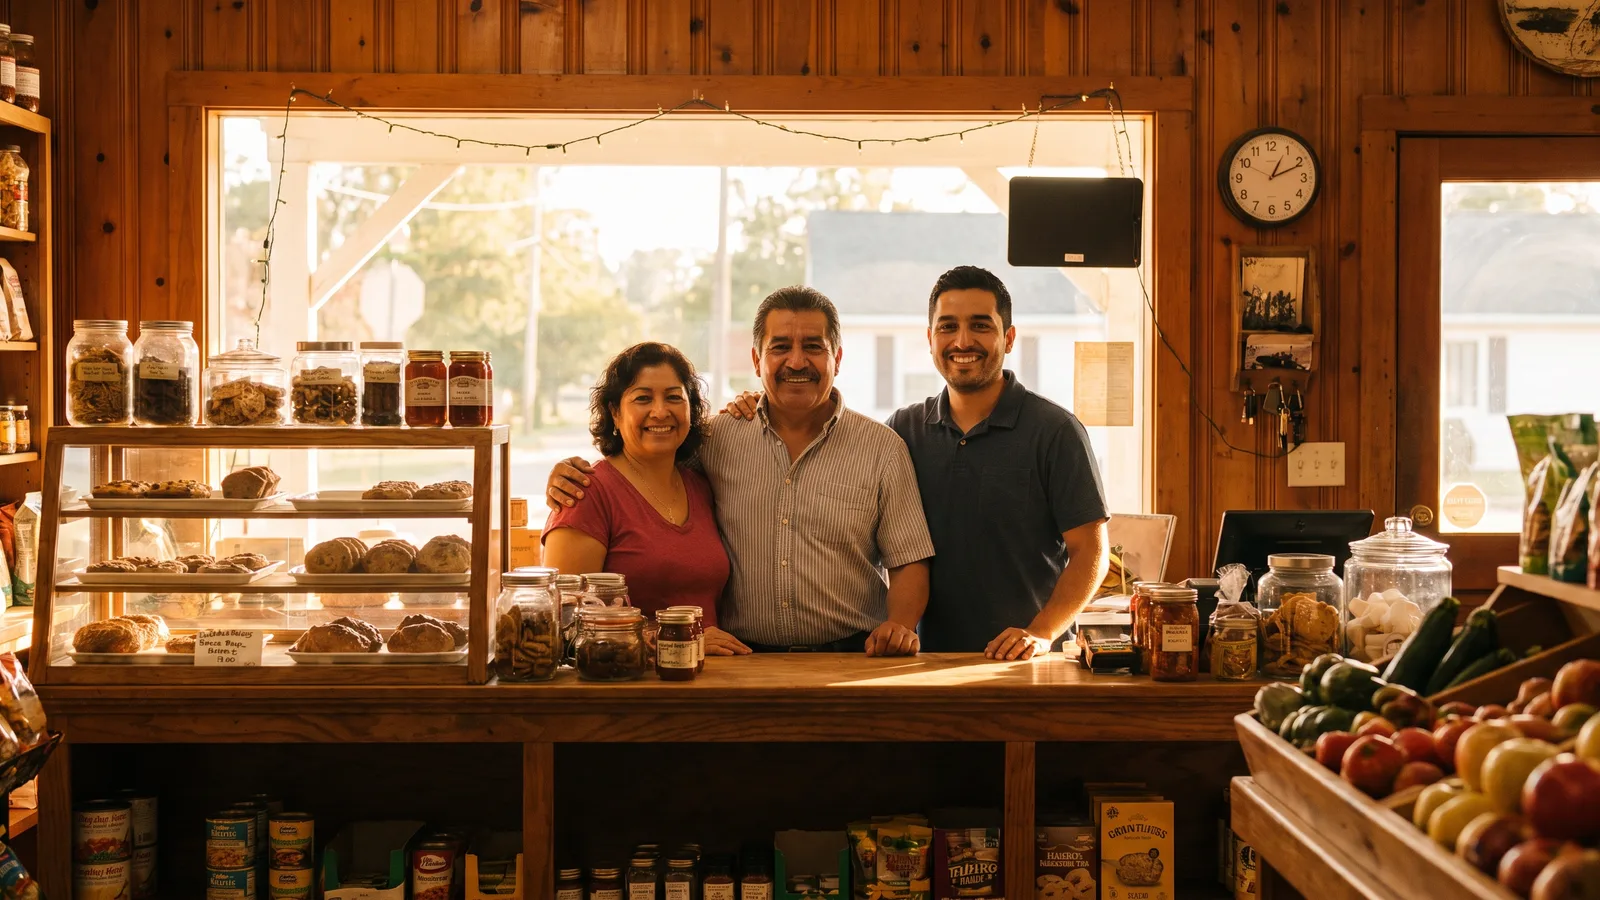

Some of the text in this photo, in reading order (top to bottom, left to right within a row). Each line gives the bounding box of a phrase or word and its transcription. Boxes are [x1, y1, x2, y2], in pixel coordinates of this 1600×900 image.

[1265, 140, 1276, 151] 12
[1251, 146, 1260, 156] 11
[1239, 158, 1251, 168] 10
[1296, 157, 1303, 167] 2
[1236, 173, 1242, 183] 9
[1300, 173, 1307, 183] 3
[1241, 189, 1247, 200] 8
[1296, 189, 1302, 198] 4
[1252, 201, 1259, 211] 7
[1268, 205, 1275, 215] 6
[1284, 200, 1291, 211] 5
